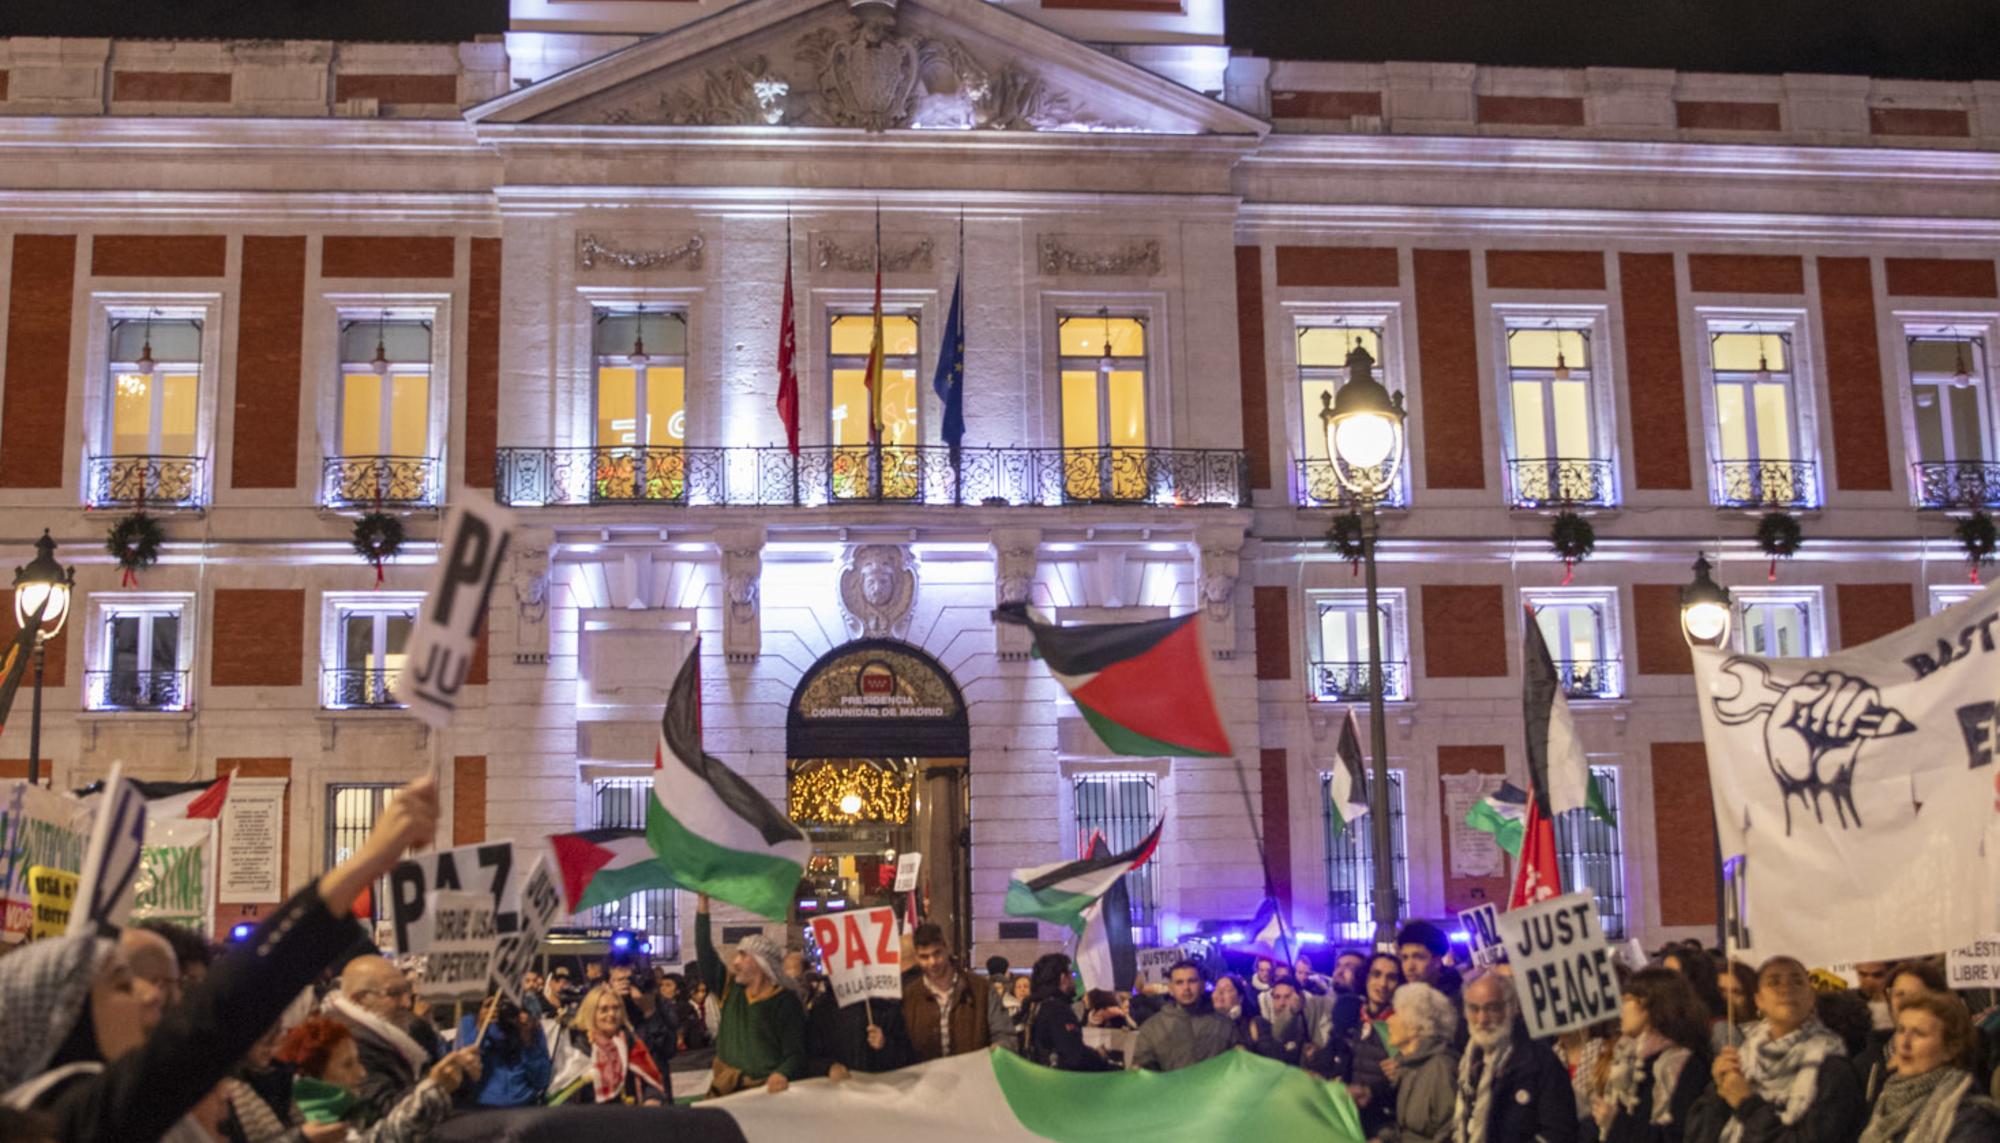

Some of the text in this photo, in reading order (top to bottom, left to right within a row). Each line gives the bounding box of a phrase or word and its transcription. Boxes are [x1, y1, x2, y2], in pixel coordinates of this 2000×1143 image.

[811, 707, 944, 718] COMUNIDAD DE MADRID
[841, 696, 914, 705] PRESIDENCIA
[391, 843, 518, 953] PAZ
[812, 909, 899, 976] PAZ
[1461, 906, 1503, 953] PAZ
[1517, 903, 1590, 957] JUST
[1526, 950, 1617, 1030] PEACE
[1953, 964, 1989, 981] LIBRE
